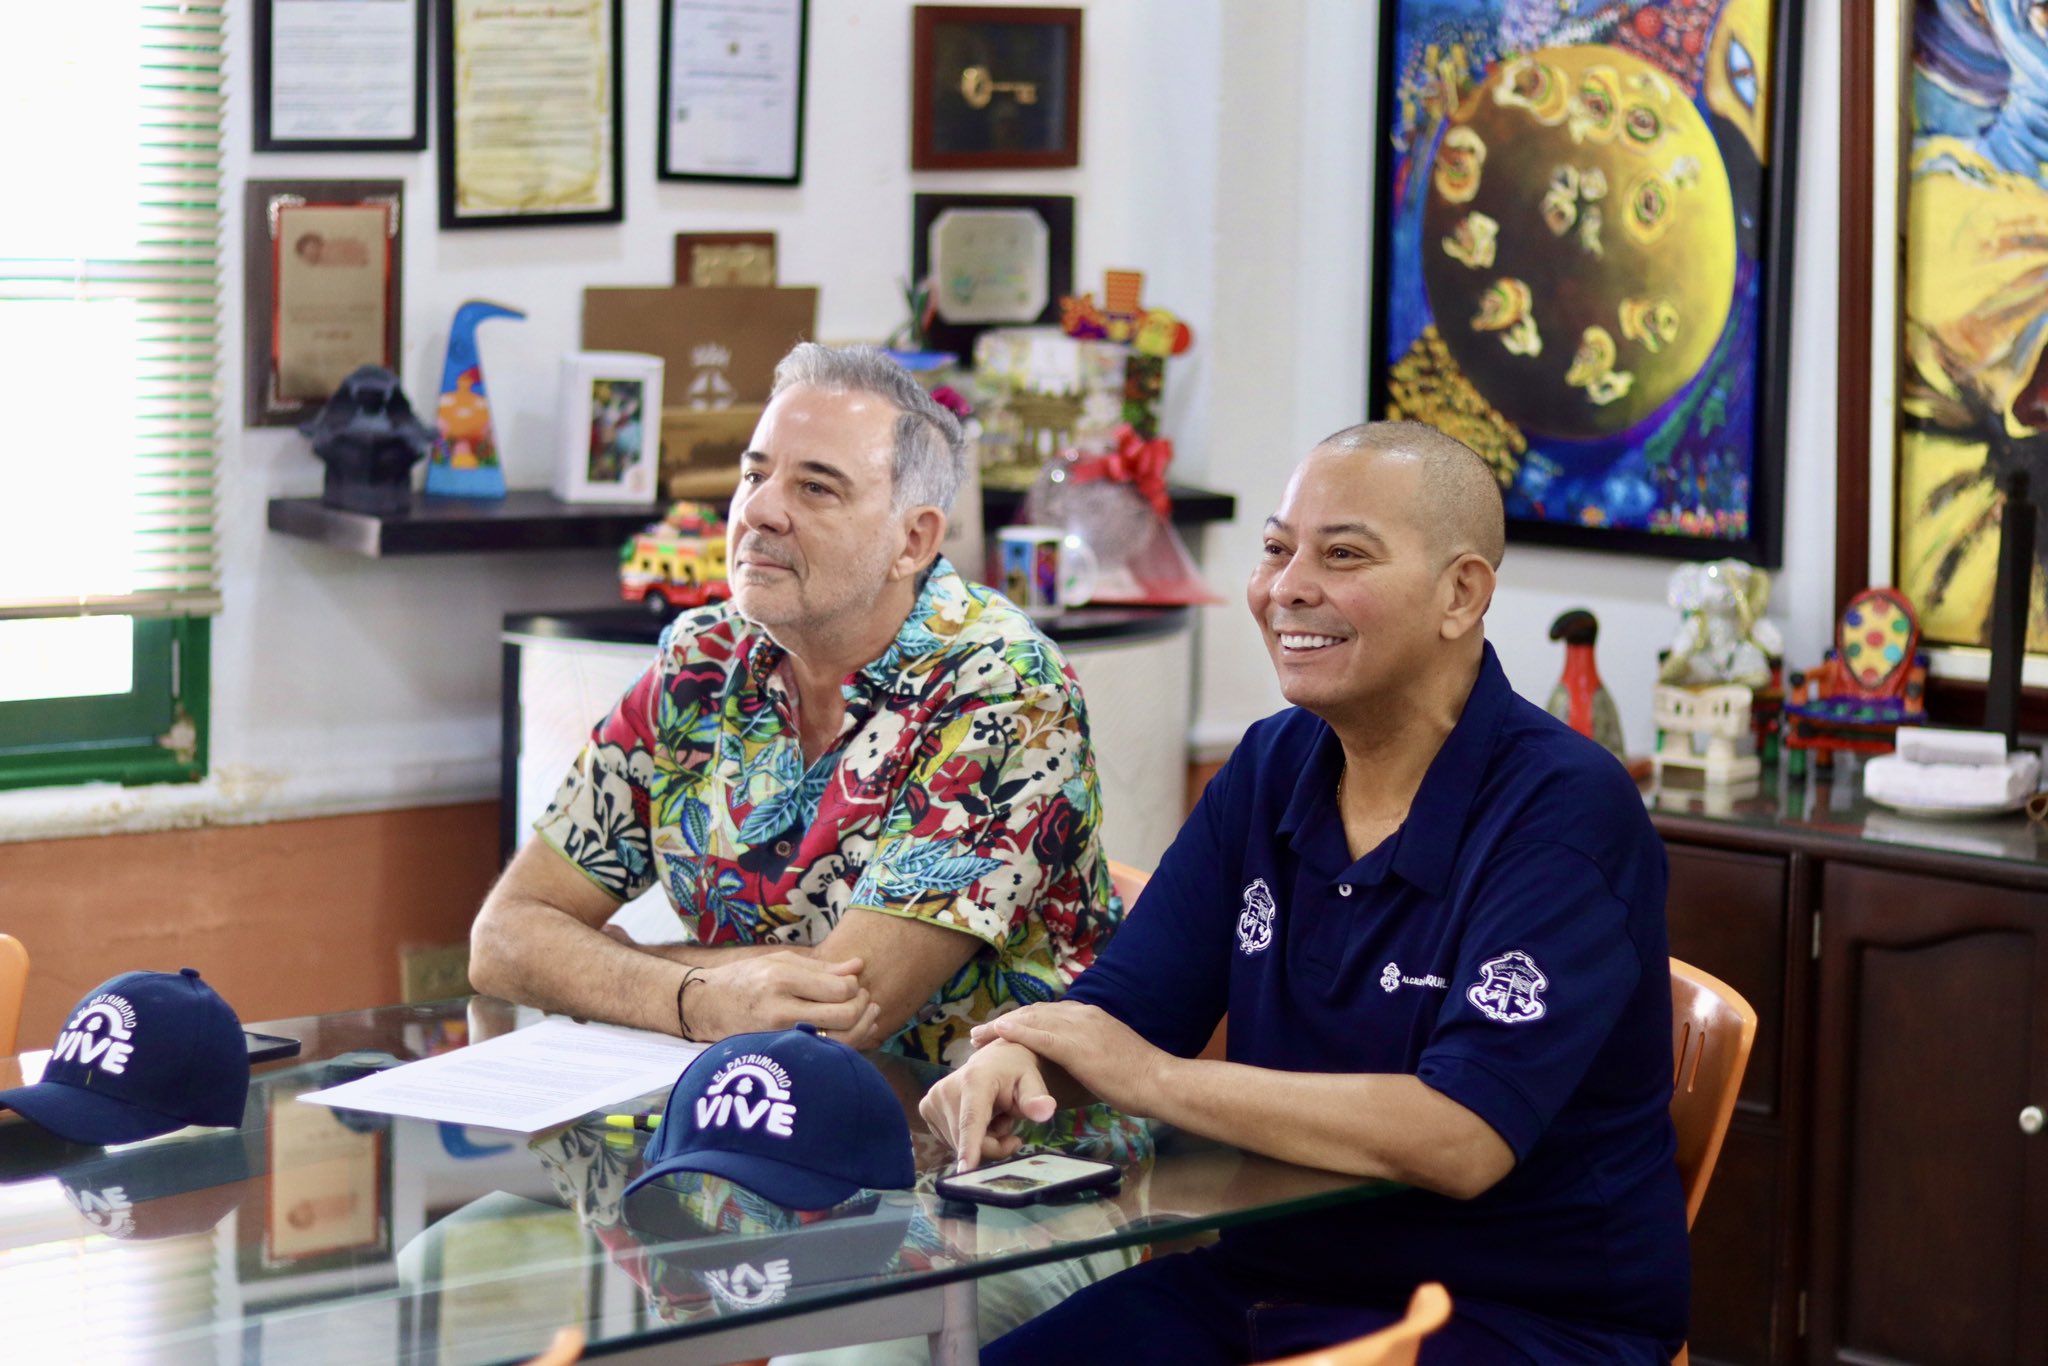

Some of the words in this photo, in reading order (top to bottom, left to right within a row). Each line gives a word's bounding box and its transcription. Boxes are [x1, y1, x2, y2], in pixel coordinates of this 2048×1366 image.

[53, 1030, 135, 1075] VIVE
[712, 1070, 727, 1083] EL
[726, 1054, 793, 1089] PATRIMONIO
[697, 1093, 797, 1137] VIVE
